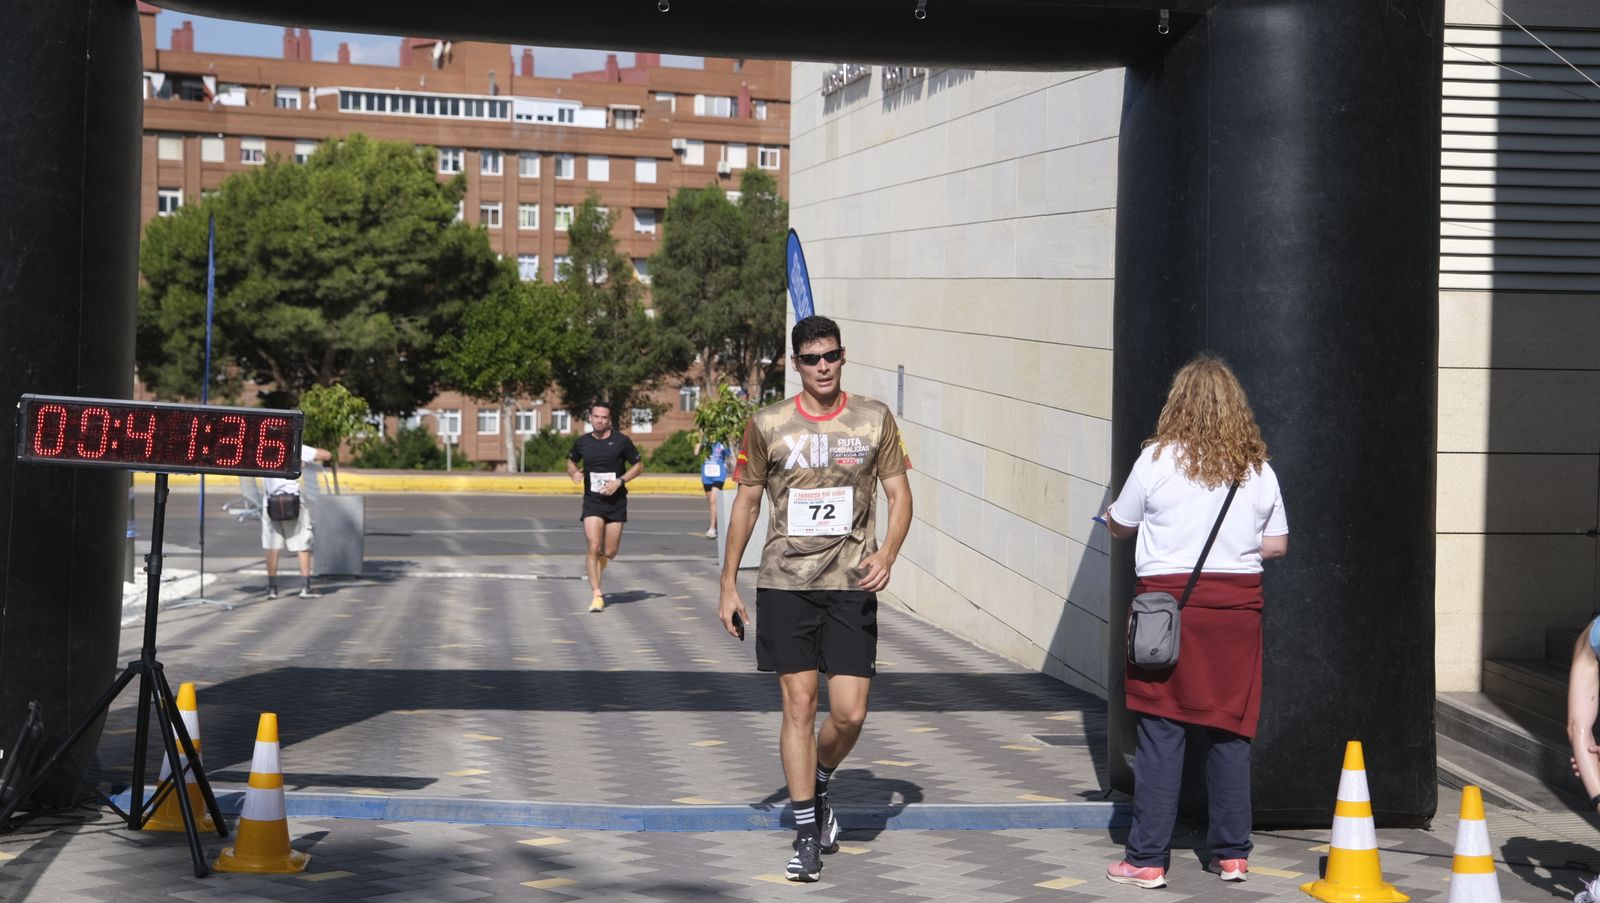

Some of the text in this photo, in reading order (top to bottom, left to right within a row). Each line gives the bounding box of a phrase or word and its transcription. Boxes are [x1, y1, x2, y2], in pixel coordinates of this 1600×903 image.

[838, 438, 861, 447] RUTA
[783, 434, 828, 469] XII
[809, 504, 835, 520] 72
